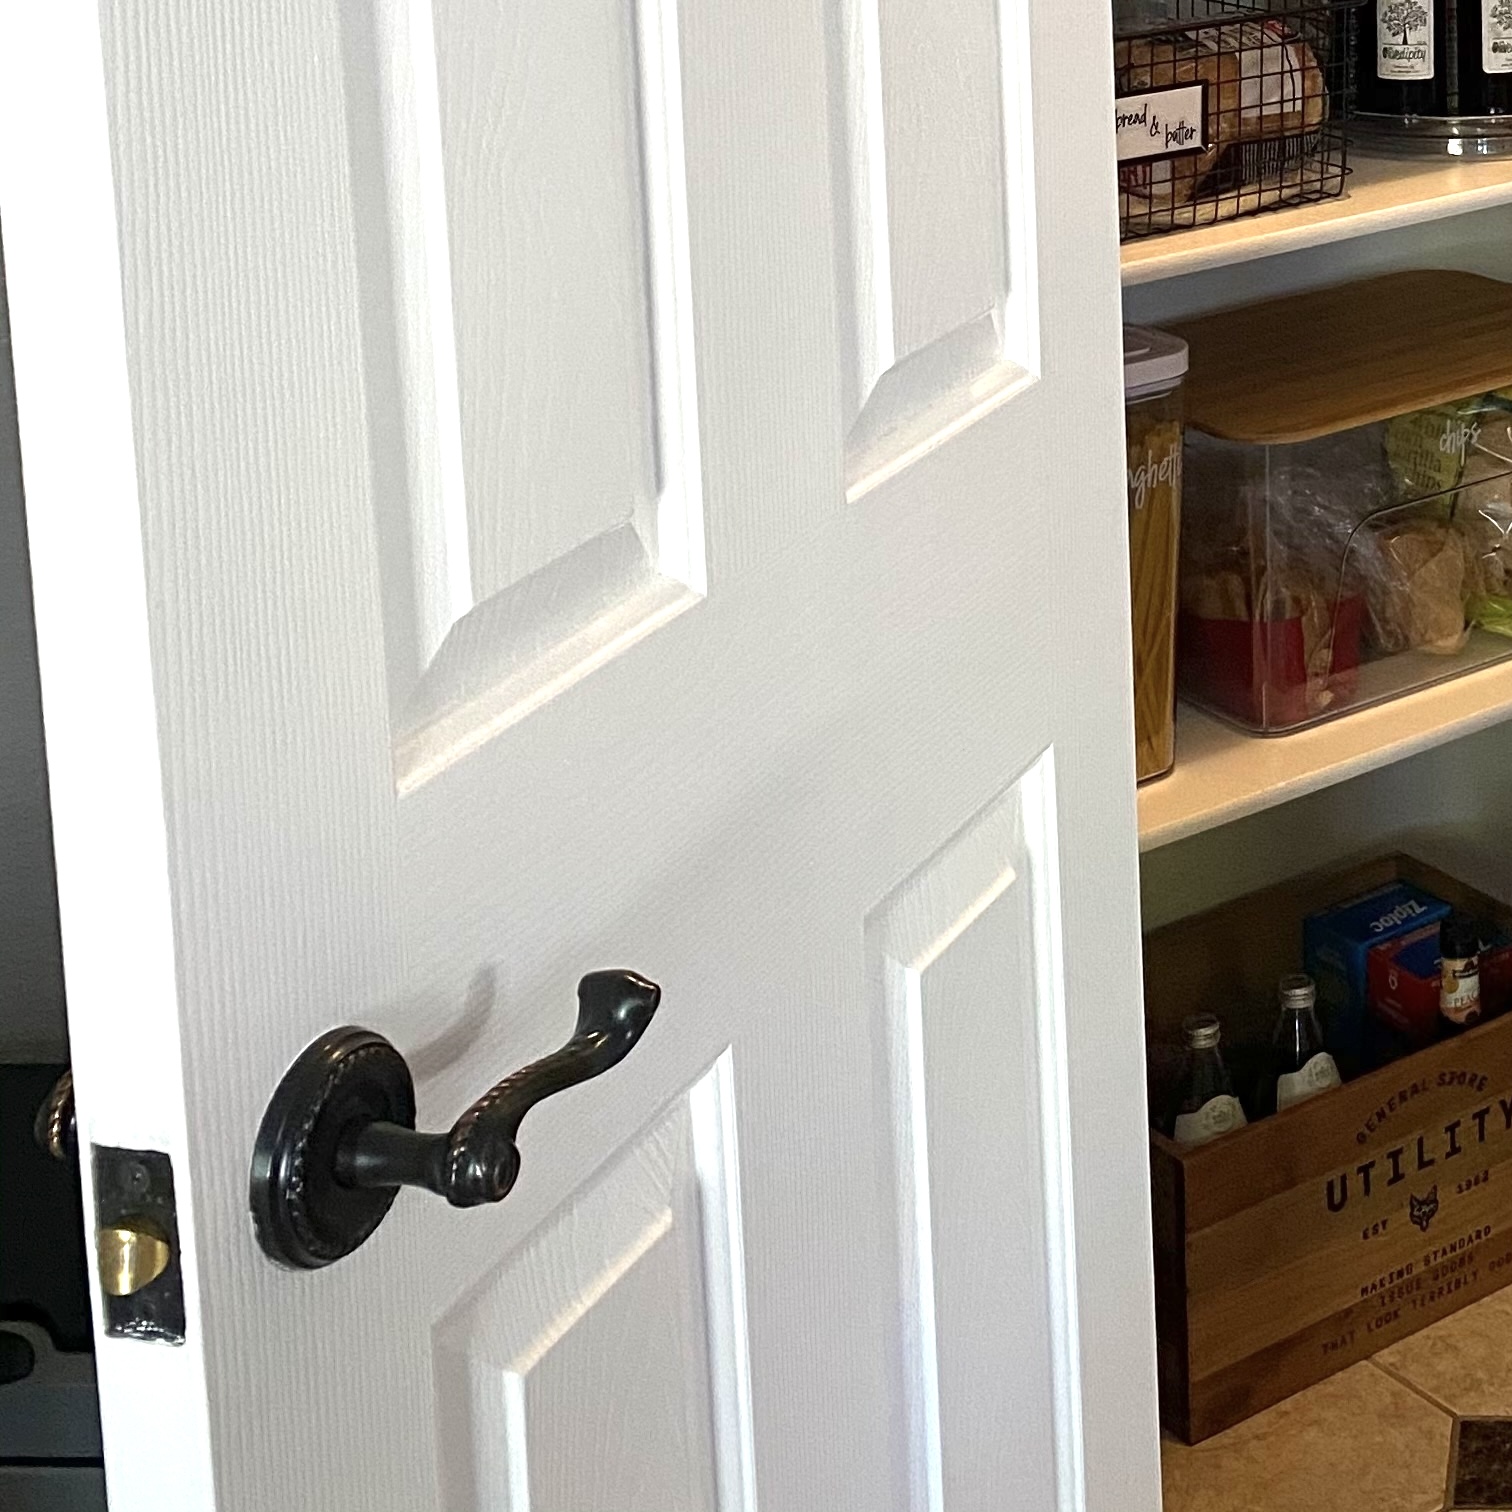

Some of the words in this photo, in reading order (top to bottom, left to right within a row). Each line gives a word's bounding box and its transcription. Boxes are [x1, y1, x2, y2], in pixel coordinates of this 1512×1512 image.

[1149, 115, 1160, 138] &
[1165, 120, 1197, 150] butter
[1439, 419, 1482, 468] chips
[1370, 899, 1428, 932] Ziploc
[1454, 989, 1481, 1009] PEAC
[1356, 1078, 1430, 1145] GENERAL
[1437, 1071, 1488, 1092] STORE
[1361, 1218, 1389, 1240] EST
[1360, 1262, 1414, 1298] MAKING
[1423, 1225, 1493, 1267] STANDARD
[1320, 1329, 1357, 1356] THAT
[1411, 1271, 1479, 1310] TERRIBLY
